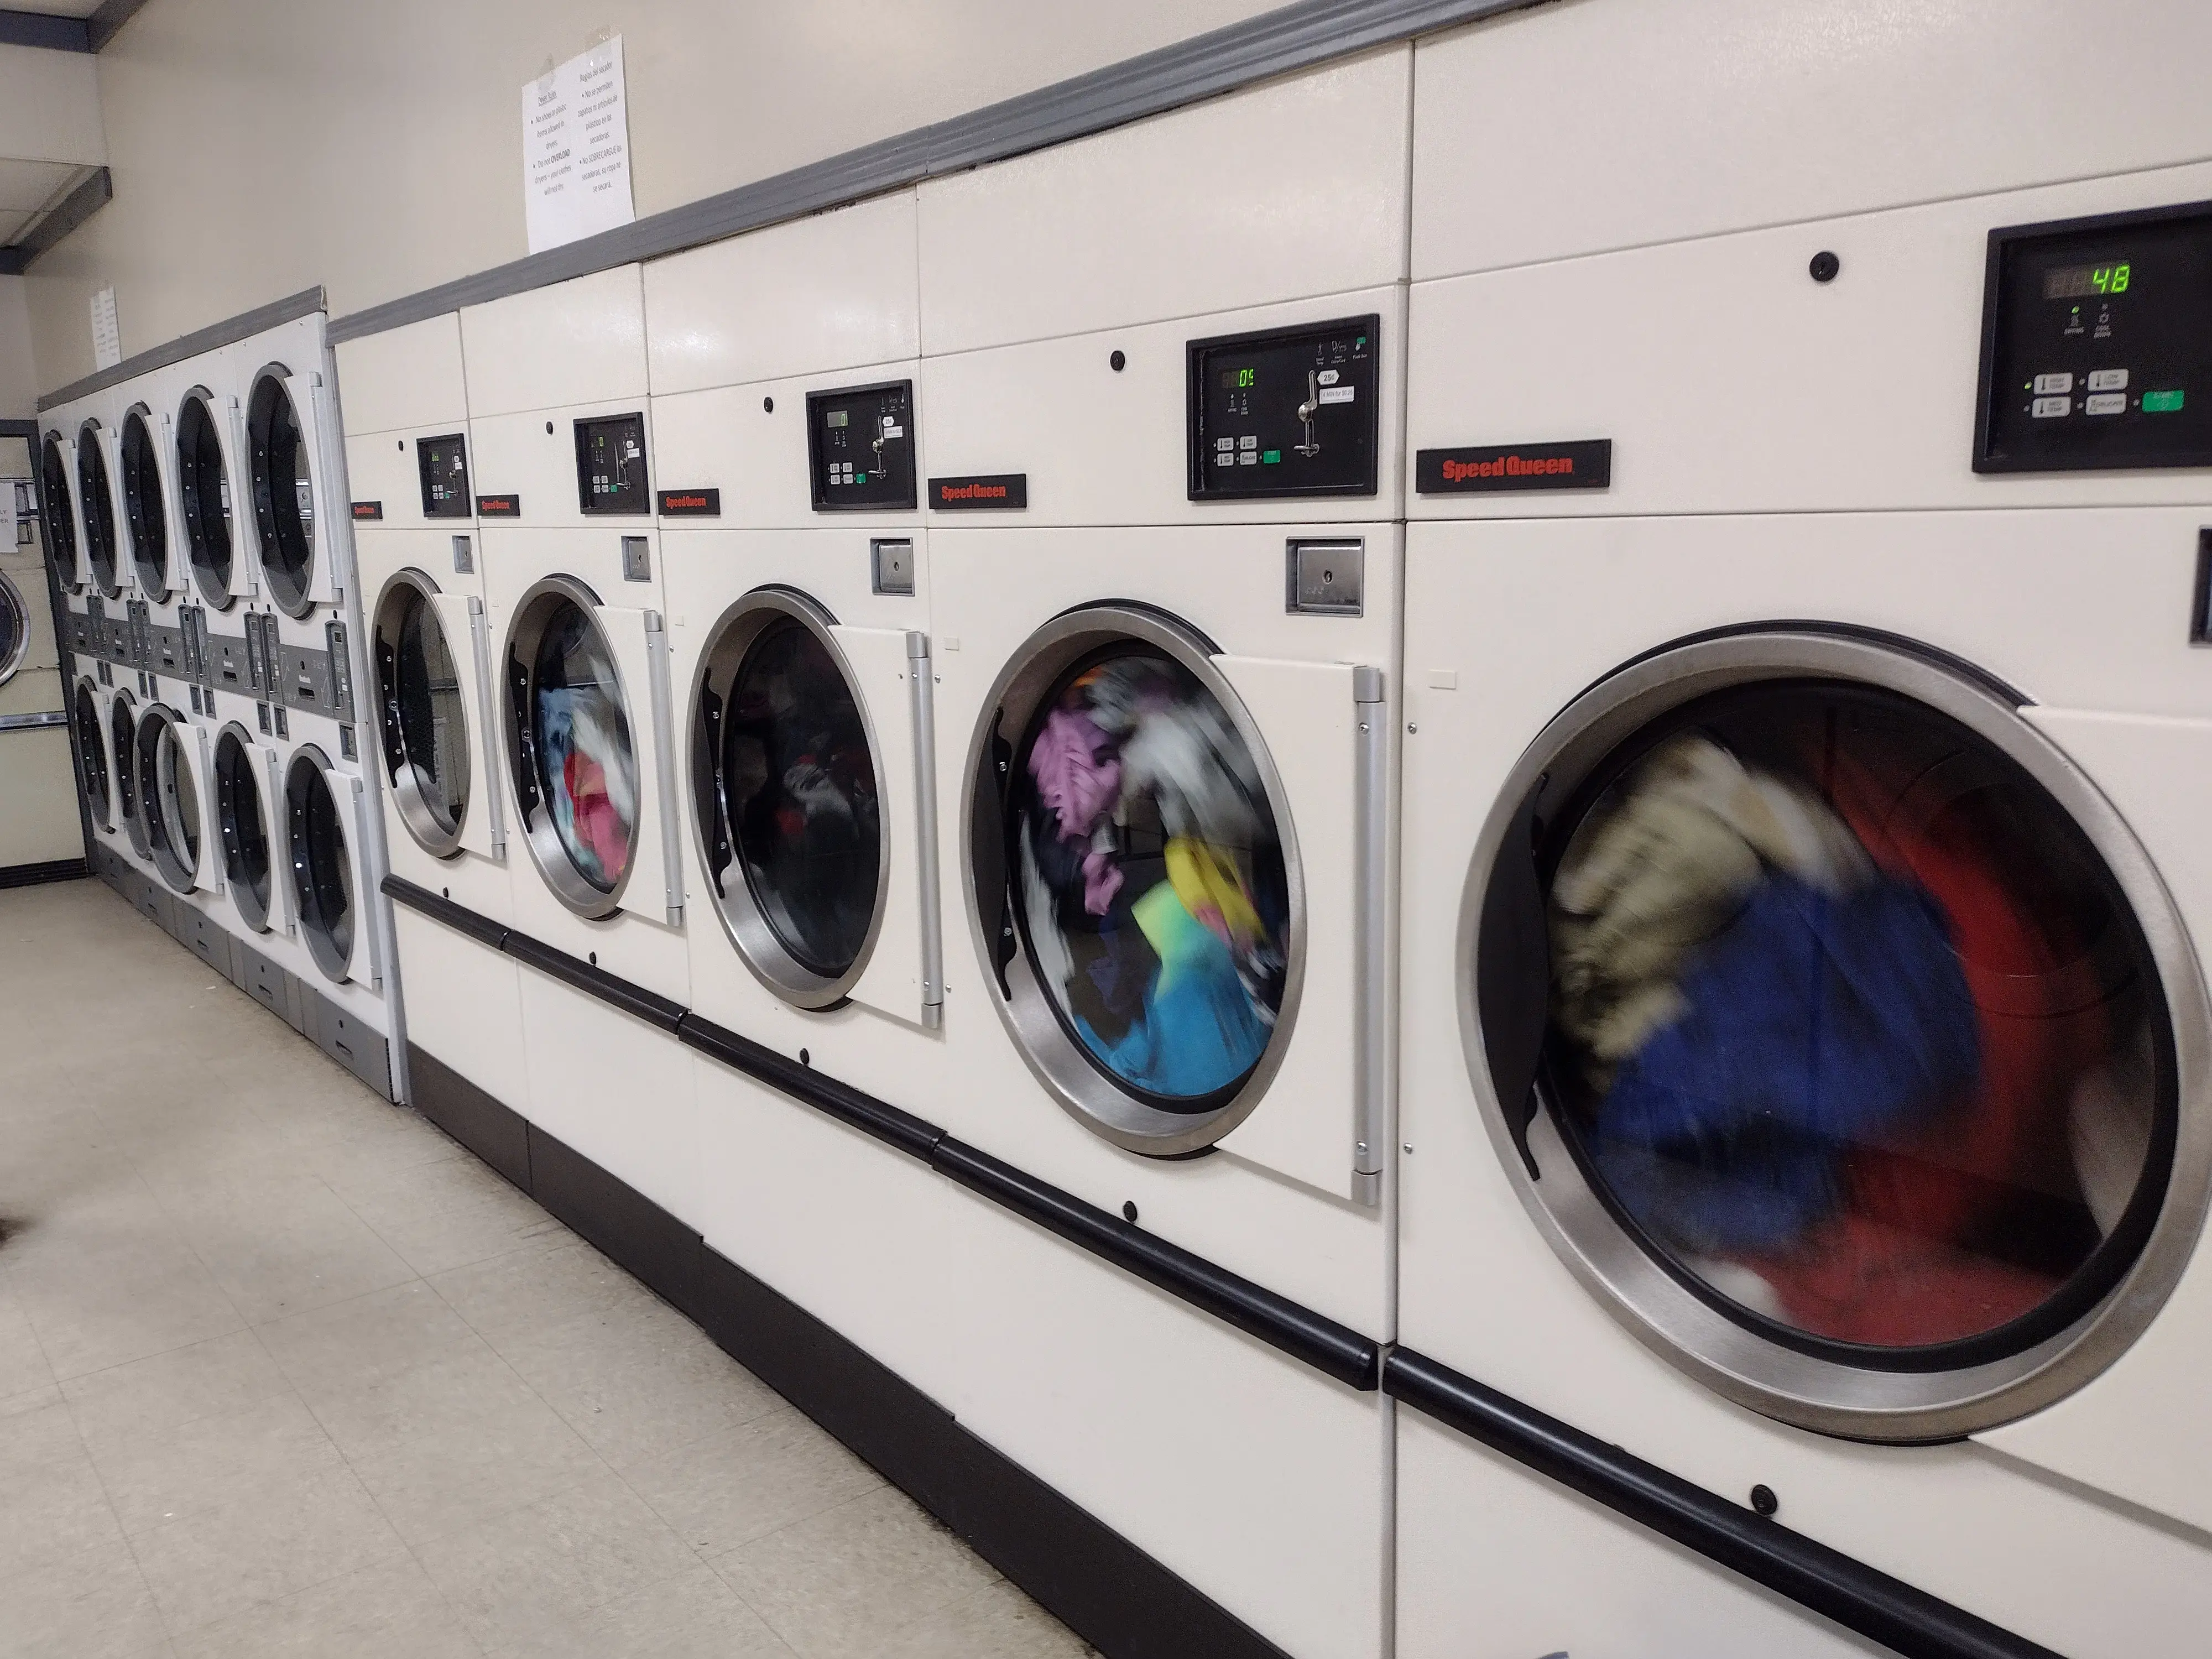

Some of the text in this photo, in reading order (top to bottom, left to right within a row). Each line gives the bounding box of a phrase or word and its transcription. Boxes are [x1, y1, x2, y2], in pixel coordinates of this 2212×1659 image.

[551, 149, 571, 164] OVERLOAD
[2093, 263, 2131, 294] 48
[1442, 455, 1573, 483] Speed Queen
[941, 483, 1006, 502] Speed Queen
